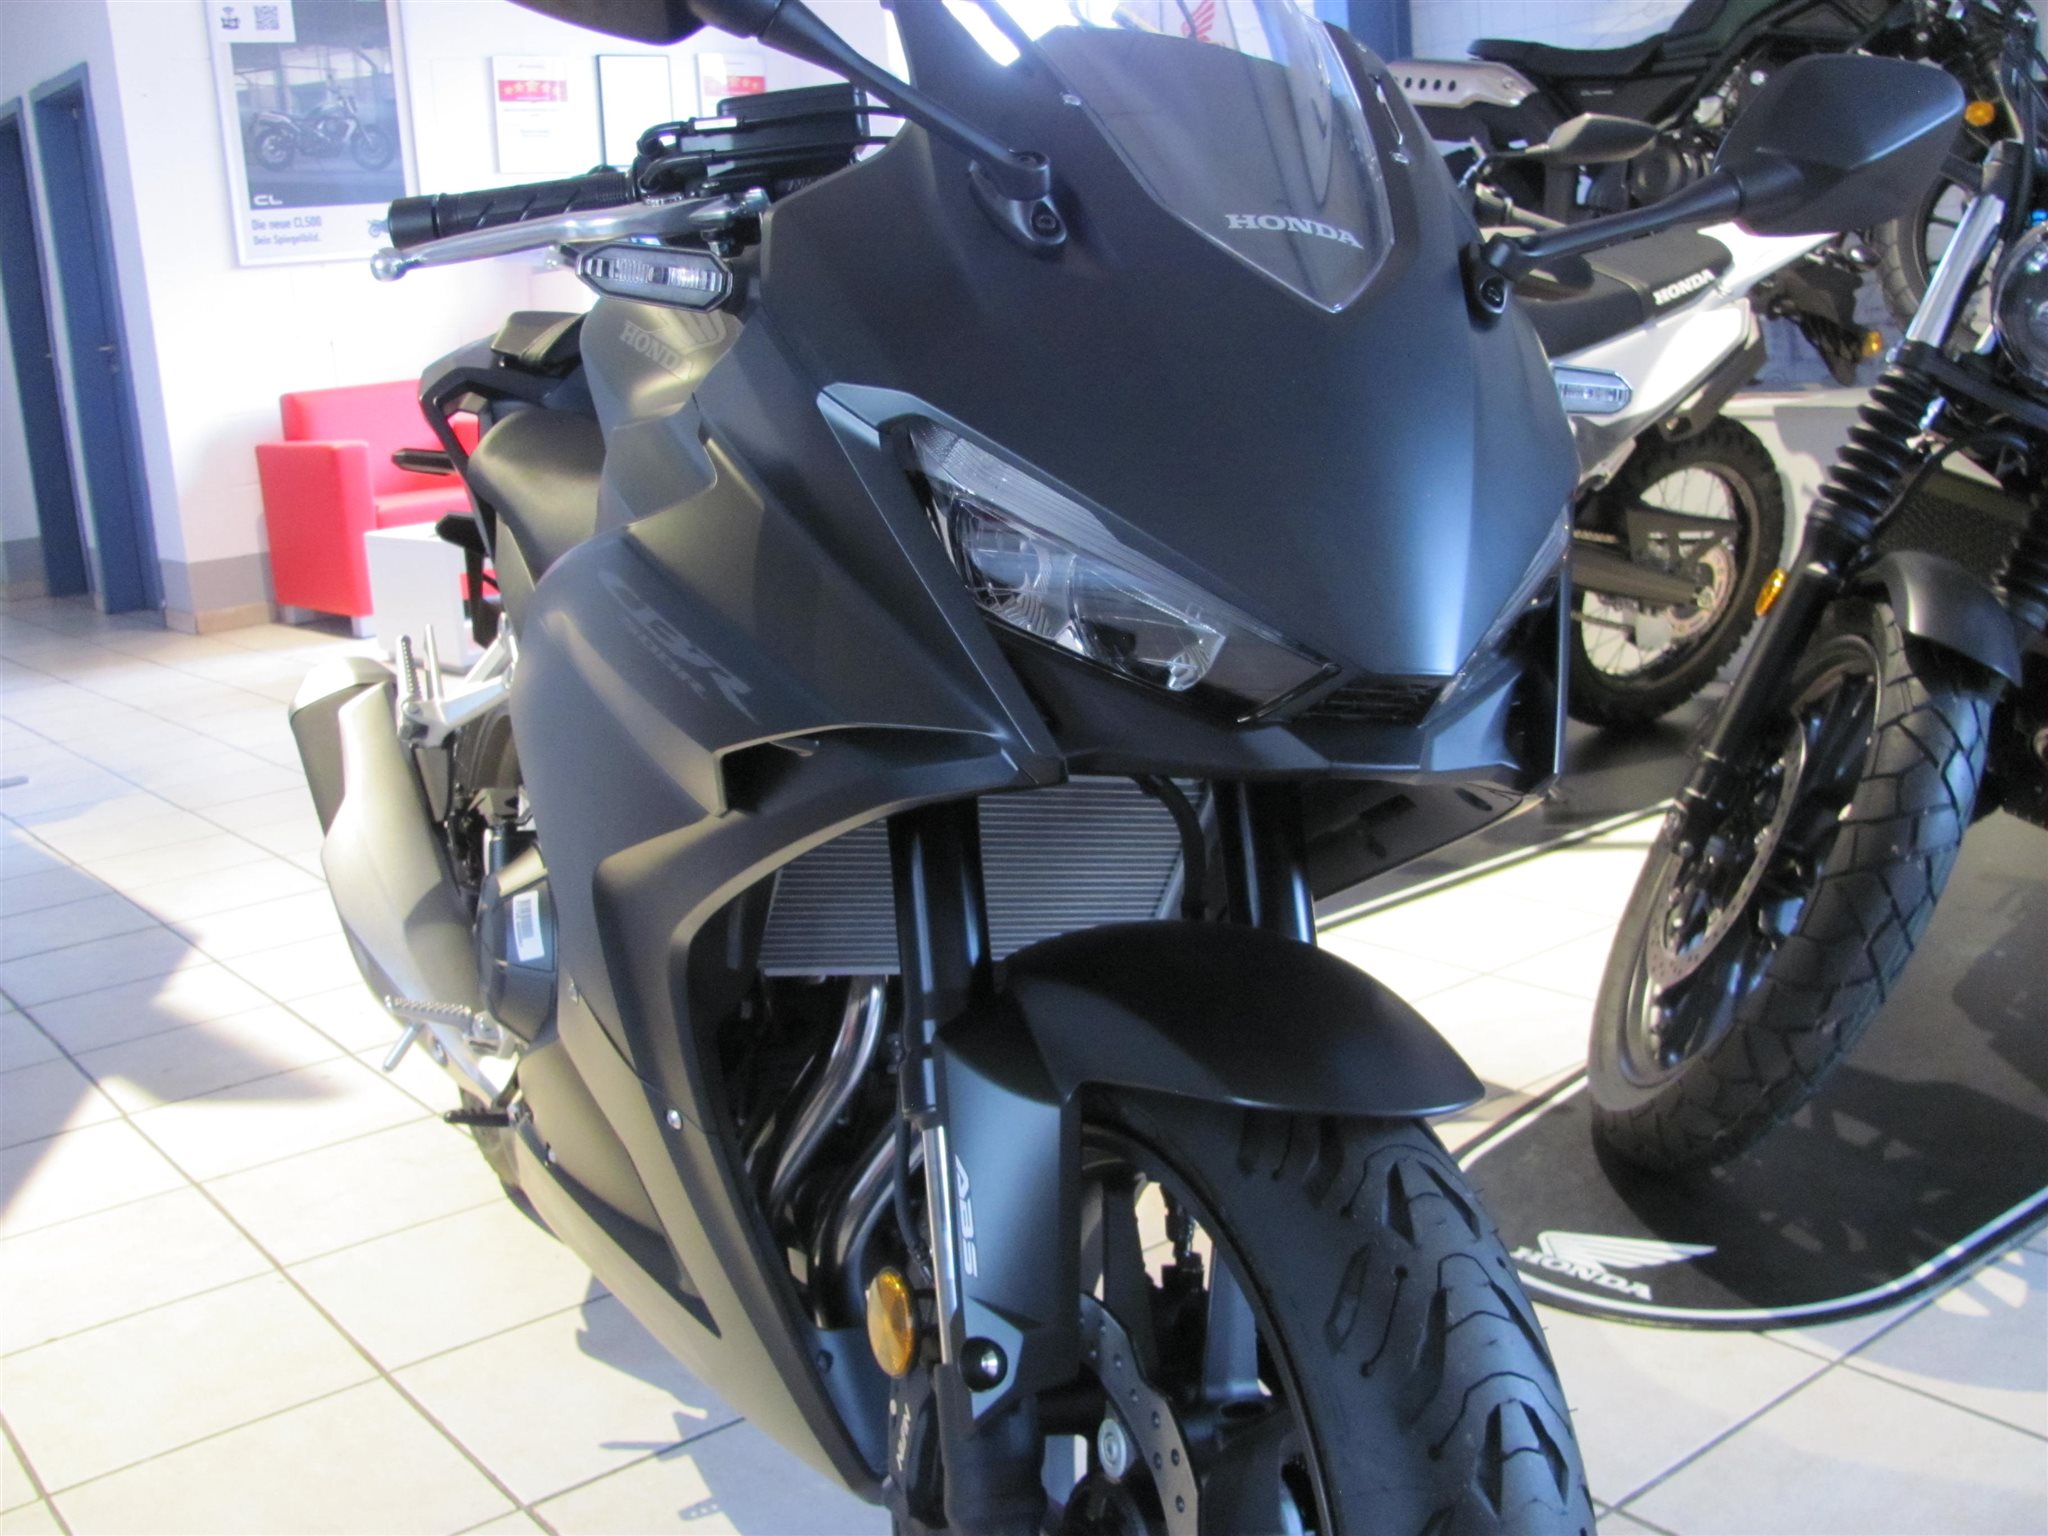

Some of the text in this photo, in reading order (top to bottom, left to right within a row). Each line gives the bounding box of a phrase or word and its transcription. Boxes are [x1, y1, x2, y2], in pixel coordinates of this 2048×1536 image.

[253, 194, 283, 206] CL
[1225, 213, 1365, 250] HONDA
[1652, 268, 1716, 306] HONDA
[955, 1153, 978, 1278] ABS
[1509, 1246, 1652, 1301] HONDA
